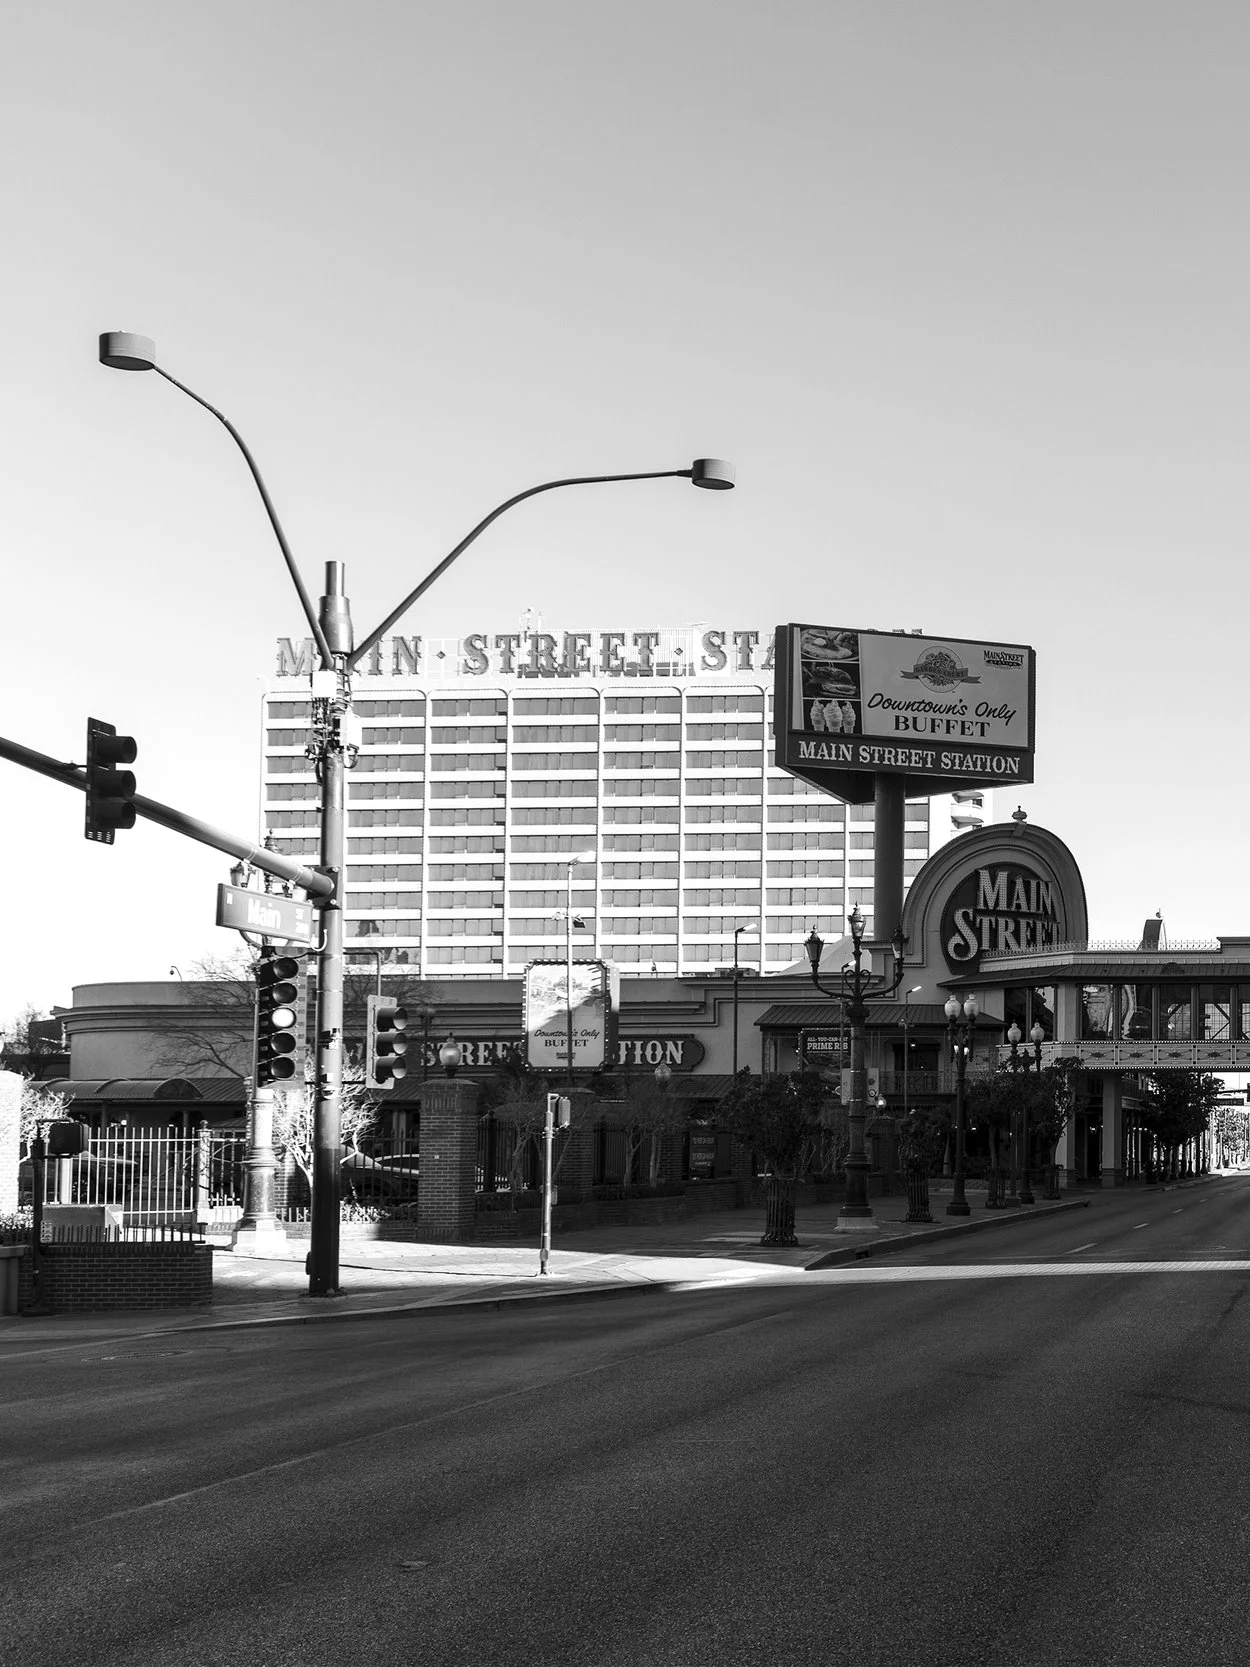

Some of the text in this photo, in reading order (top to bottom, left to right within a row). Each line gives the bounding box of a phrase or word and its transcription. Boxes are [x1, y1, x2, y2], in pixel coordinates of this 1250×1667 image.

[276, 635, 422, 676] MIN
[463, 631, 659, 675] STREET
[868, 693, 1017, 726] Downtown's Only
[894, 715, 990, 737] BUFFET
[799, 741, 1020, 774] MAIN STREET STATION
[977, 868, 1055, 915] MAIN
[247, 898, 281, 930] Main
[948, 908, 1060, 961] STREET
[533, 1028, 600, 1039] Downtow's Only
[544, 1039, 589, 1047] BUFET
[807, 1042, 848, 1050] PRIME RB
